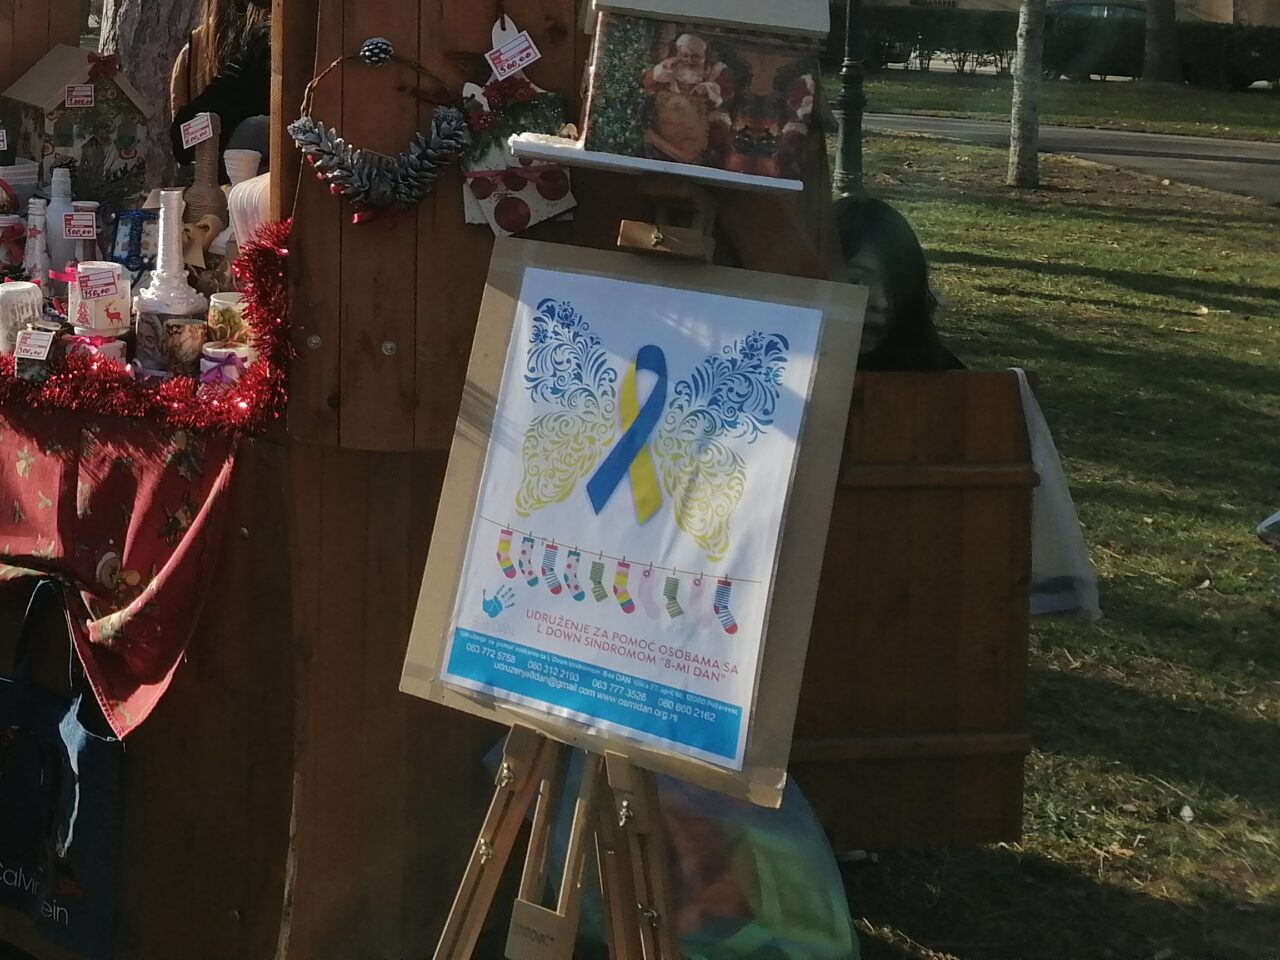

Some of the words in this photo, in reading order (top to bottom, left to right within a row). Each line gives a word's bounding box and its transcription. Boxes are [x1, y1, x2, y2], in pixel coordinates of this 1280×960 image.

[66, 228, 93, 238] 500,00
[525, 609, 589, 635] UDRUŽENJE
[592, 626, 609, 640] ZA
[612, 630, 656, 651] POMOĆ
[658, 644, 720, 670] OSOBAMA
[723, 661, 739, 675] SA
[536, 623, 543, 634] L
[545, 625, 581, 644] DOWN
[584, 636, 656, 665] SINDROMOM
[481, 647, 496, 659] 772
[543, 664, 559, 676] 312
[609, 682, 625, 695] 777
[40, 899, 69, 926] ein
